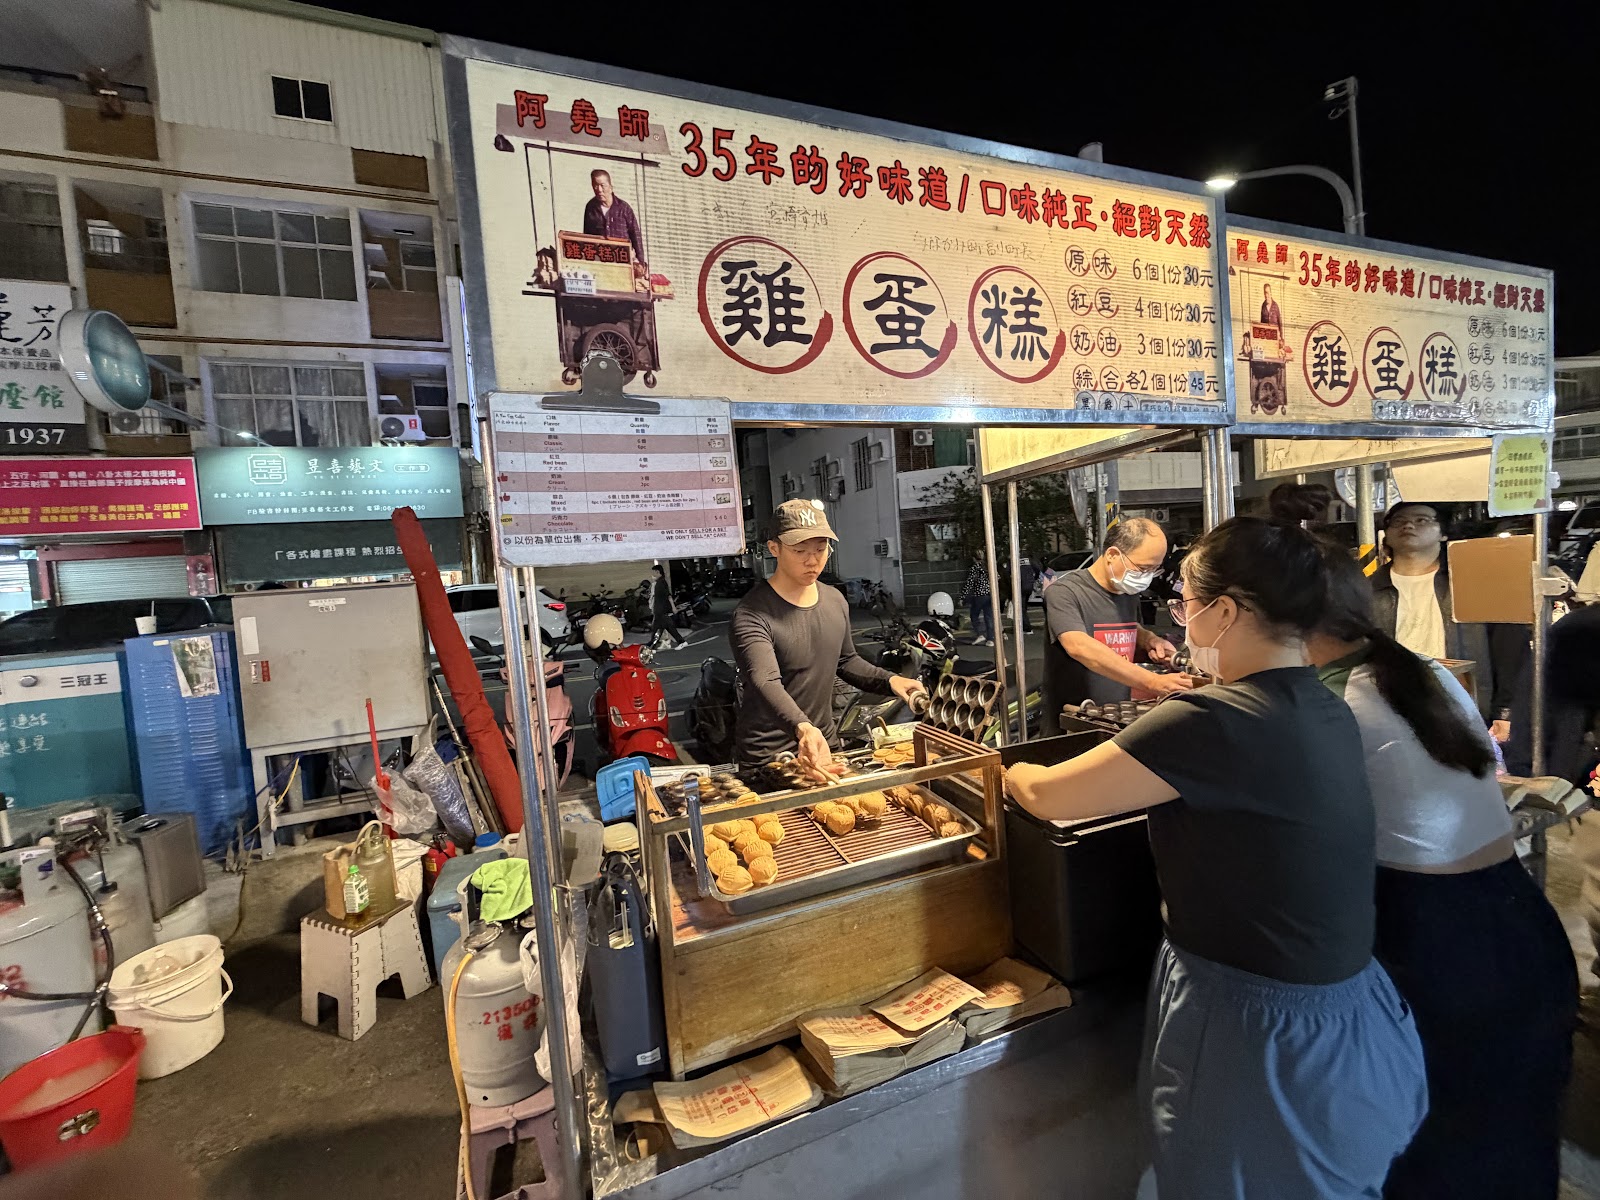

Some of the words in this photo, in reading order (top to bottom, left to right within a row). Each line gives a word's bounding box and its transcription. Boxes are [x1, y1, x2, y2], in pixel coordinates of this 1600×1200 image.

[514, 90, 650, 141] 阿堯師
[1069, 249, 1113, 276] 原味
[1236, 238, 1289, 265] 阿堯師
[720, 260, 1051, 362] 雞蛋糕
[1071, 290, 1115, 314] 紅豆
[1073, 330, 1118, 353] 奶油
[1312, 335, 1458, 396] 雞蛋糕
[1076, 369, 1119, 391] 綜合
[6, 428, 65, 445] 1937
[305, 458, 385, 474] 昱喜藝文
[1104, 631, 1138, 645] WARHO
[60, 673, 108, 689] 三冠王
